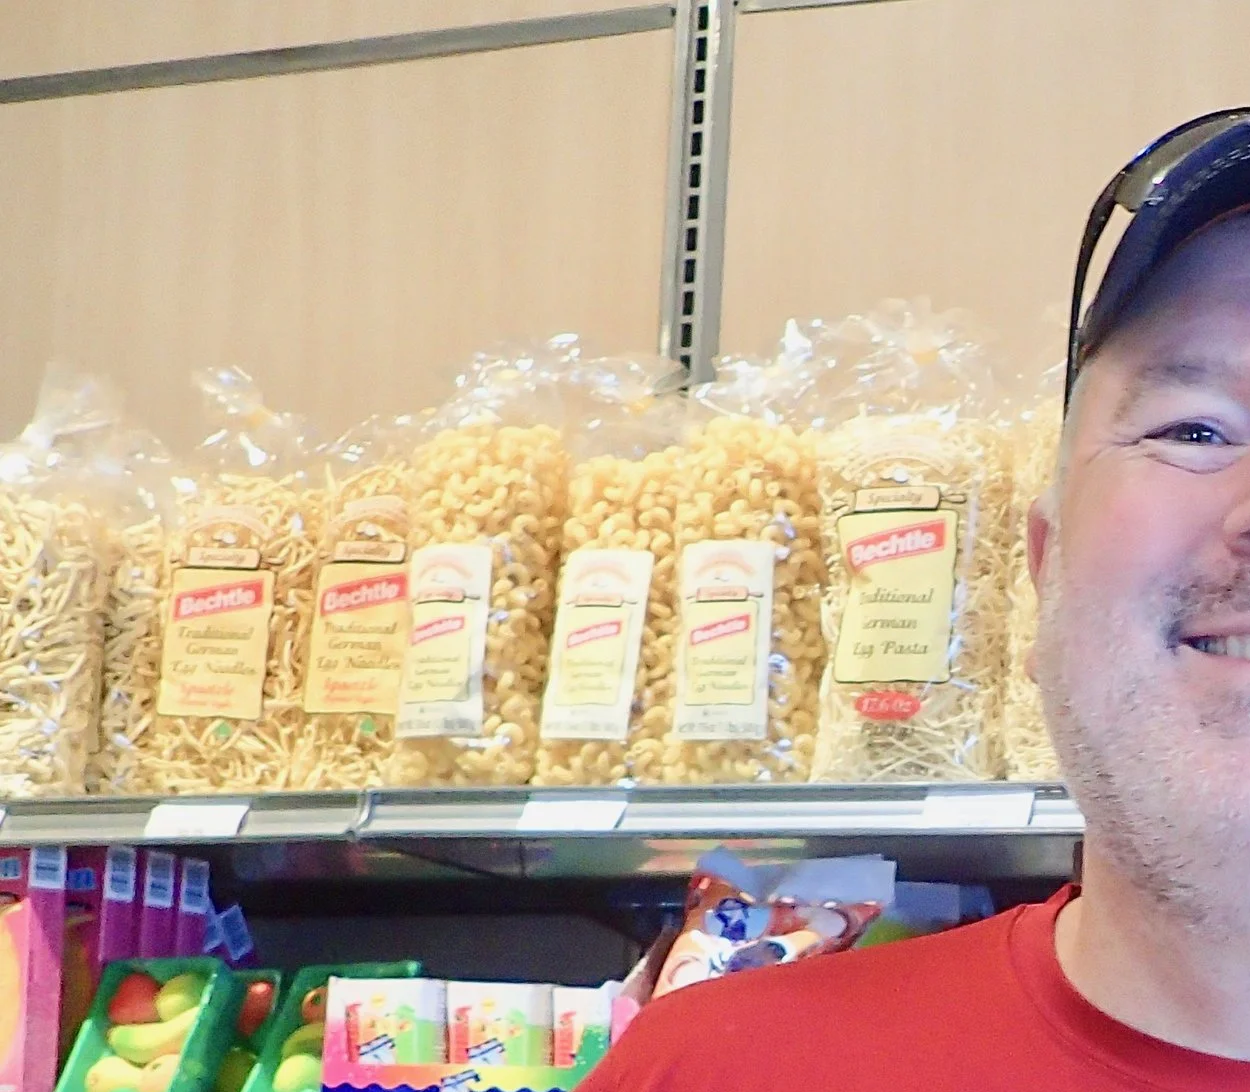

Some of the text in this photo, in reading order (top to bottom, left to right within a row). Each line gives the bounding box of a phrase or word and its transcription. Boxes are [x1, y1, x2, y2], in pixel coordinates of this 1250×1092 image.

[851, 529, 936, 564] Bechtle
[180, 588, 256, 616] Bechtle
[323, 582, 399, 612] Bechtle
[882, 638, 929, 655] Pasta
